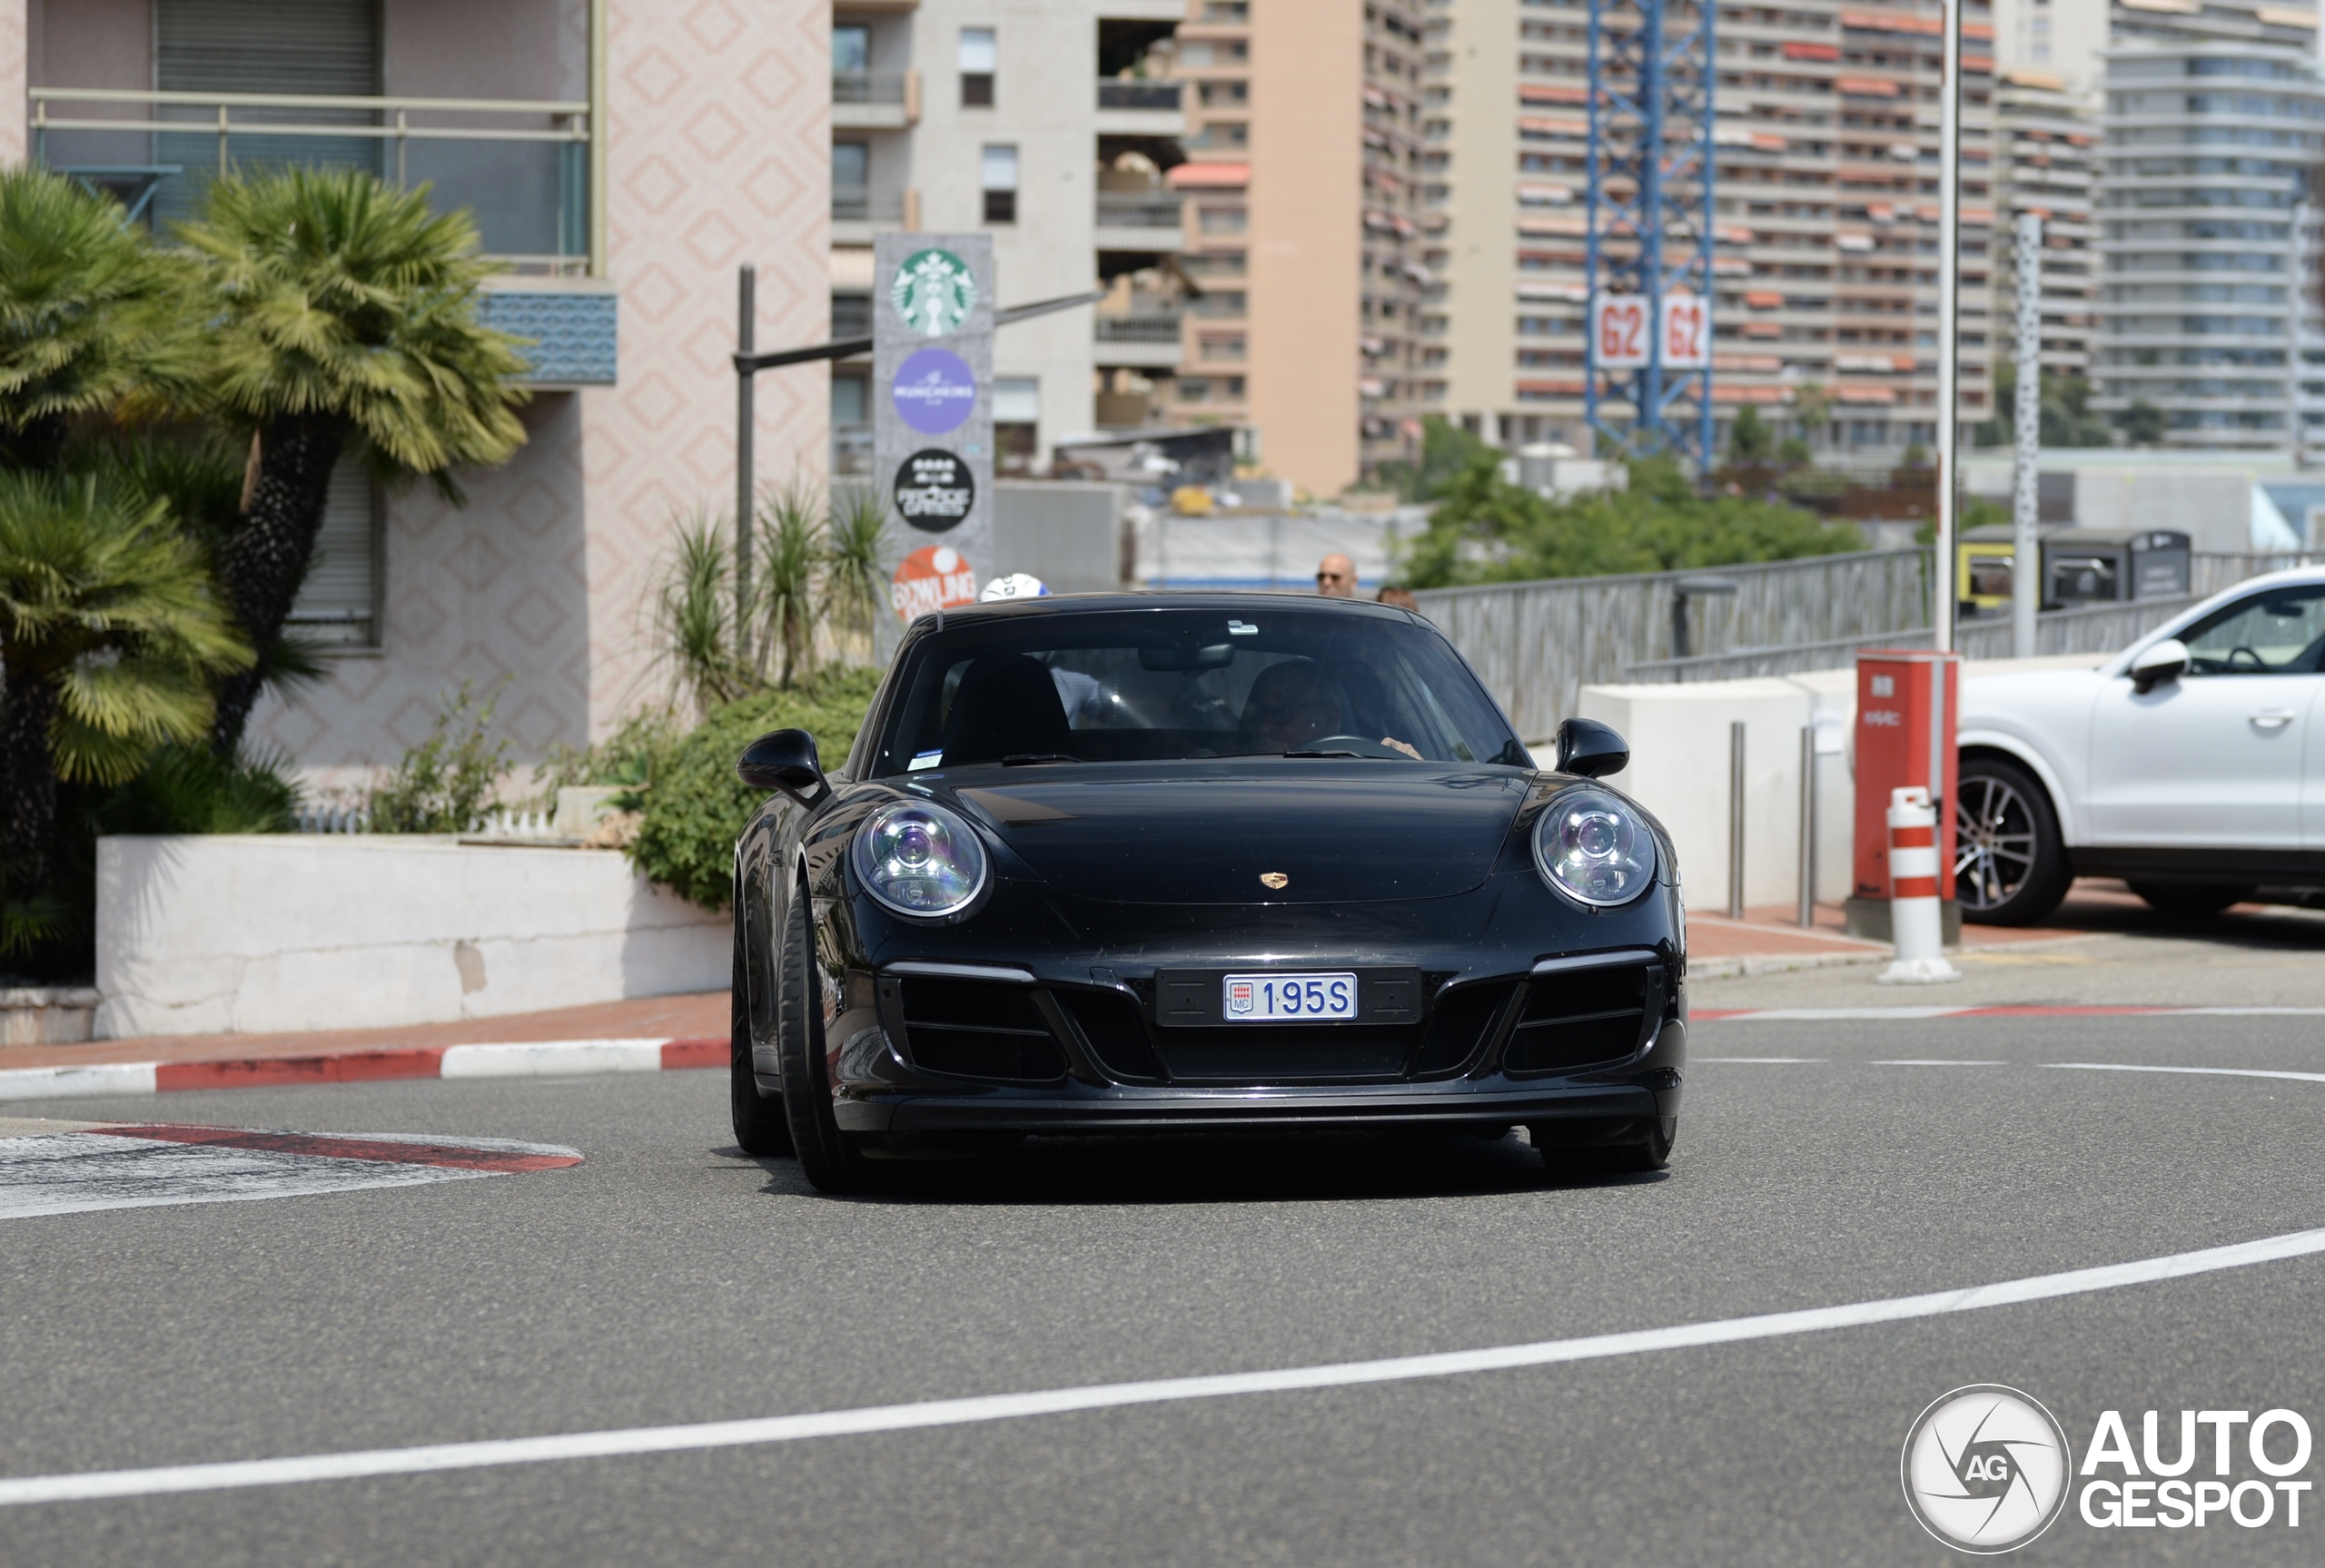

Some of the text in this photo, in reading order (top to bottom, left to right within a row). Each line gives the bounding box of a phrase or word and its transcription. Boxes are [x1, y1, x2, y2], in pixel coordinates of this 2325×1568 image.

[897, 486, 971, 505] ARCADE
[903, 503, 965, 517] GAMES
[891, 571, 976, 611] BOWLING
[1234, 981, 1349, 1014] MC 195S
